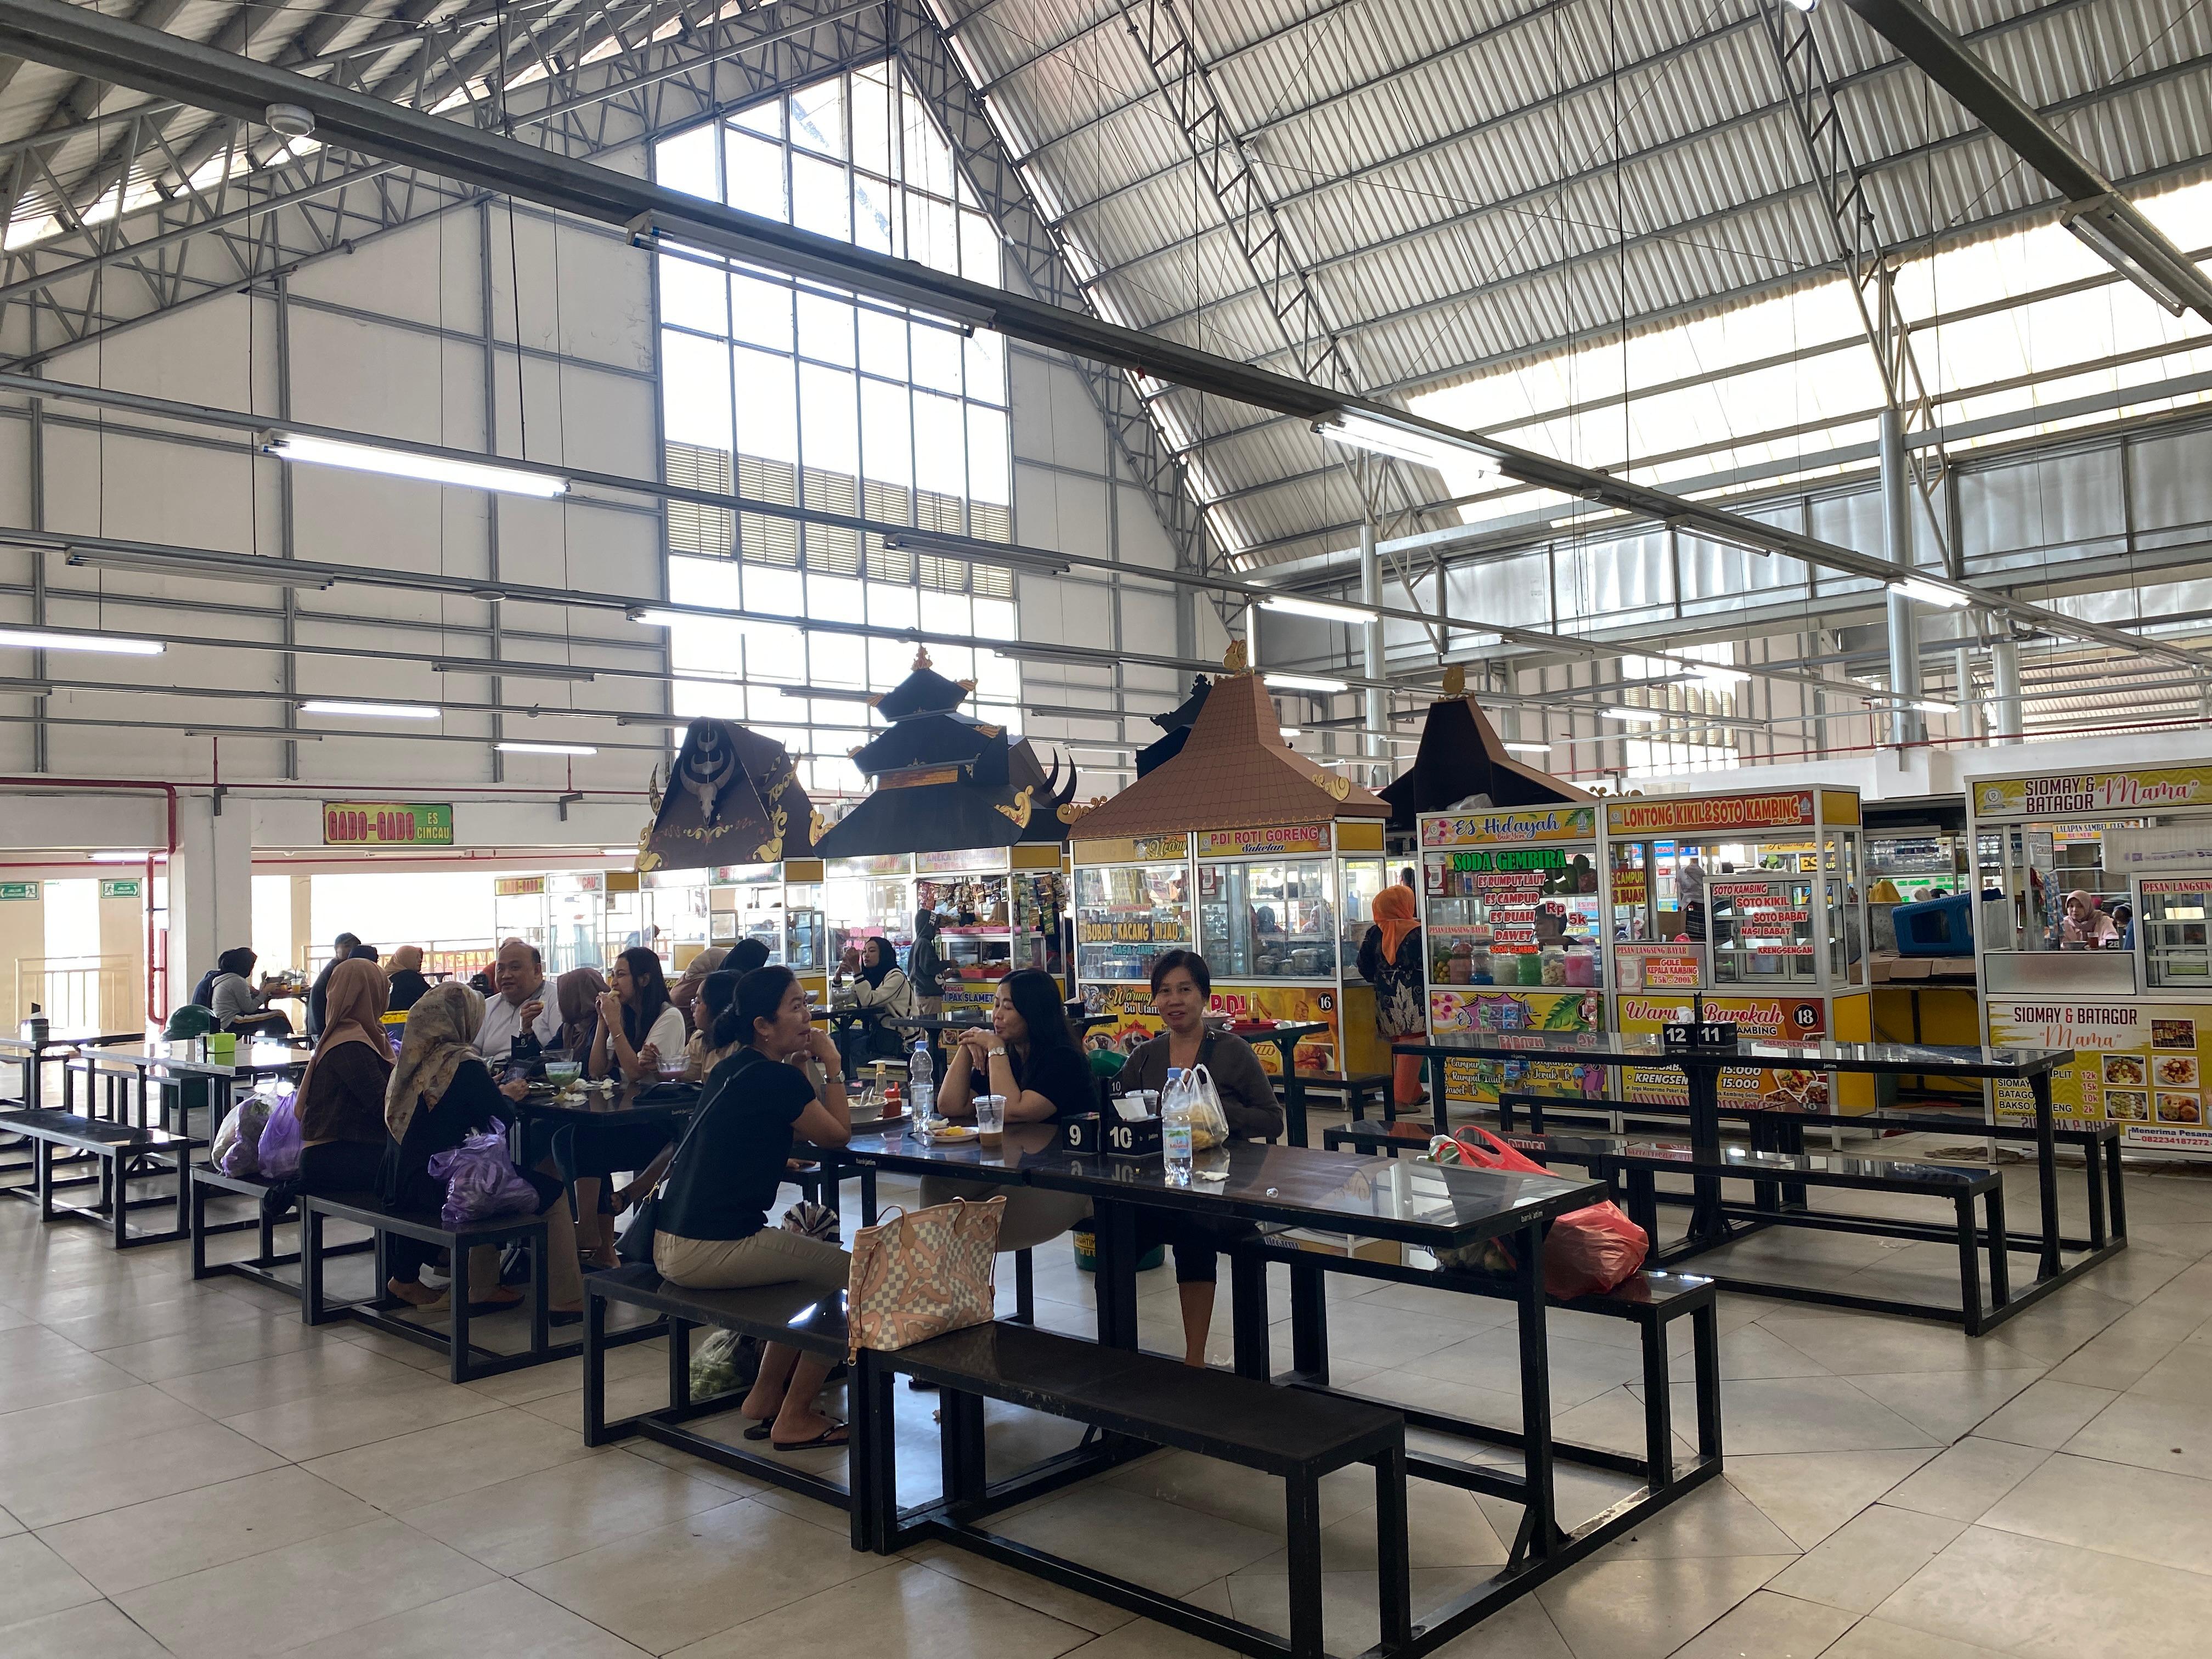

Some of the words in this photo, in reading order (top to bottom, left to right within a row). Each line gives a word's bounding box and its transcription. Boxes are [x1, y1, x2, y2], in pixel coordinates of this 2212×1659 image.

[2024, 777, 2080, 796] SIOMAY
[2085, 776, 2095, 793] &
[2026, 793, 2094, 813] BATAGOR
[1623, 804, 1673, 828] LONTONG
[1745, 794, 1799, 821] KAMBING
[427, 812, 438, 825] ES
[1482, 812, 1561, 838] Hidayah
[1771, 817, 1784, 825] Bu
[328, 811, 415, 841] GADO-GADO
[416, 826, 449, 839] CINCAU
[1210, 833, 1231, 845] P.DI
[1234, 830, 1262, 844] ROTI
[1265, 826, 1318, 842] GORENG
[926, 852, 951, 862] ANEKA
[1453, 852, 1493, 872] SODA
[1496, 849, 1568, 871] GEMBIRA
[1477, 876, 1488, 888] ES
[1488, 874, 1523, 887] RUMPUT
[1523, 873, 1547, 887] LAUT
[1617, 871, 1644, 884] CAMPUR
[1713, 885, 1733, 895] SOTO
[1734, 883, 1767, 895] KAMBING
[2143, 882, 2170, 892] PESAN
[1485, 893, 1496, 905] ES
[1497, 891, 1540, 905] CAMPUR
[1621, 888, 1645, 903] BUAH
[1736, 898, 1762, 908] SOTO
[1763, 896, 1790, 907] KIKIL
[1545, 901, 1566, 918] Rp
[1489, 911, 1502, 924] ES
[1503, 910, 1536, 923] BUAH
[1568, 912, 1588, 927] 5k
[1753, 912, 1777, 923] SOTO
[1779, 911, 1808, 922] BABAT
[1086, 923, 1113, 941] BUBUR
[1116, 922, 1149, 941] KACANG
[1154, 922, 1178, 941] HIJAU
[1429, 926, 1444, 934] PESAN
[1471, 926, 1488, 934] BAYAR
[1493, 929, 1534, 943] DAWET
[1741, 927, 1760, 935] NASI
[1764, 927, 1791, 935] BABAT
[1112, 944, 1133, 955] RASA
[1136, 944, 1155, 955] JAHE
[1490, 945, 1508, 954] SODA
[1509, 945, 1538, 954] GEMBIRA
[1616, 946, 1634, 954] PESAN
[1667, 946, 1687, 955] BAYAR
[1757, 946, 1813, 955] KRENGSENGAN
[2107, 940, 2119, 949] 28
[1647, 966, 1669, 974] KEPALA
[1669, 966, 1697, 974] KAMBING
[949, 993, 963, 1002] PAK
[964, 993, 994, 1003] SLAMET
[1320, 996, 1332, 1009] 16
[1124, 1001, 1136, 1013] Bu
[1703, 1003, 1785, 1025] Barokah
[1797, 1009, 1814, 1024] 18
[2015, 1007, 2061, 1023] SIOMAY
[2066, 1008, 2073, 1023] &
[2078, 1008, 2137, 1025] BATAGOR
[1666, 1028, 1686, 1042] 12
[1701, 1028, 1720, 1042] 11
[2081, 1071, 2097, 1081] 12k
[1111, 1081, 1121, 1092] 10
[1722, 1077, 1760, 1090] 15.000
[1997, 1079, 2030, 1088] SIOMAY
[2082, 1082, 2098, 1092] 15k
[2083, 1094, 2098, 1103] 10k
[1999, 1101, 2030, 1110] BAKSO
[2083, 1105, 2094, 1114] 2k
[1069, 1125, 1082, 1146] 9
[1109, 1126, 1133, 1149] 10
[2131, 1127, 2177, 1136] Menerima
